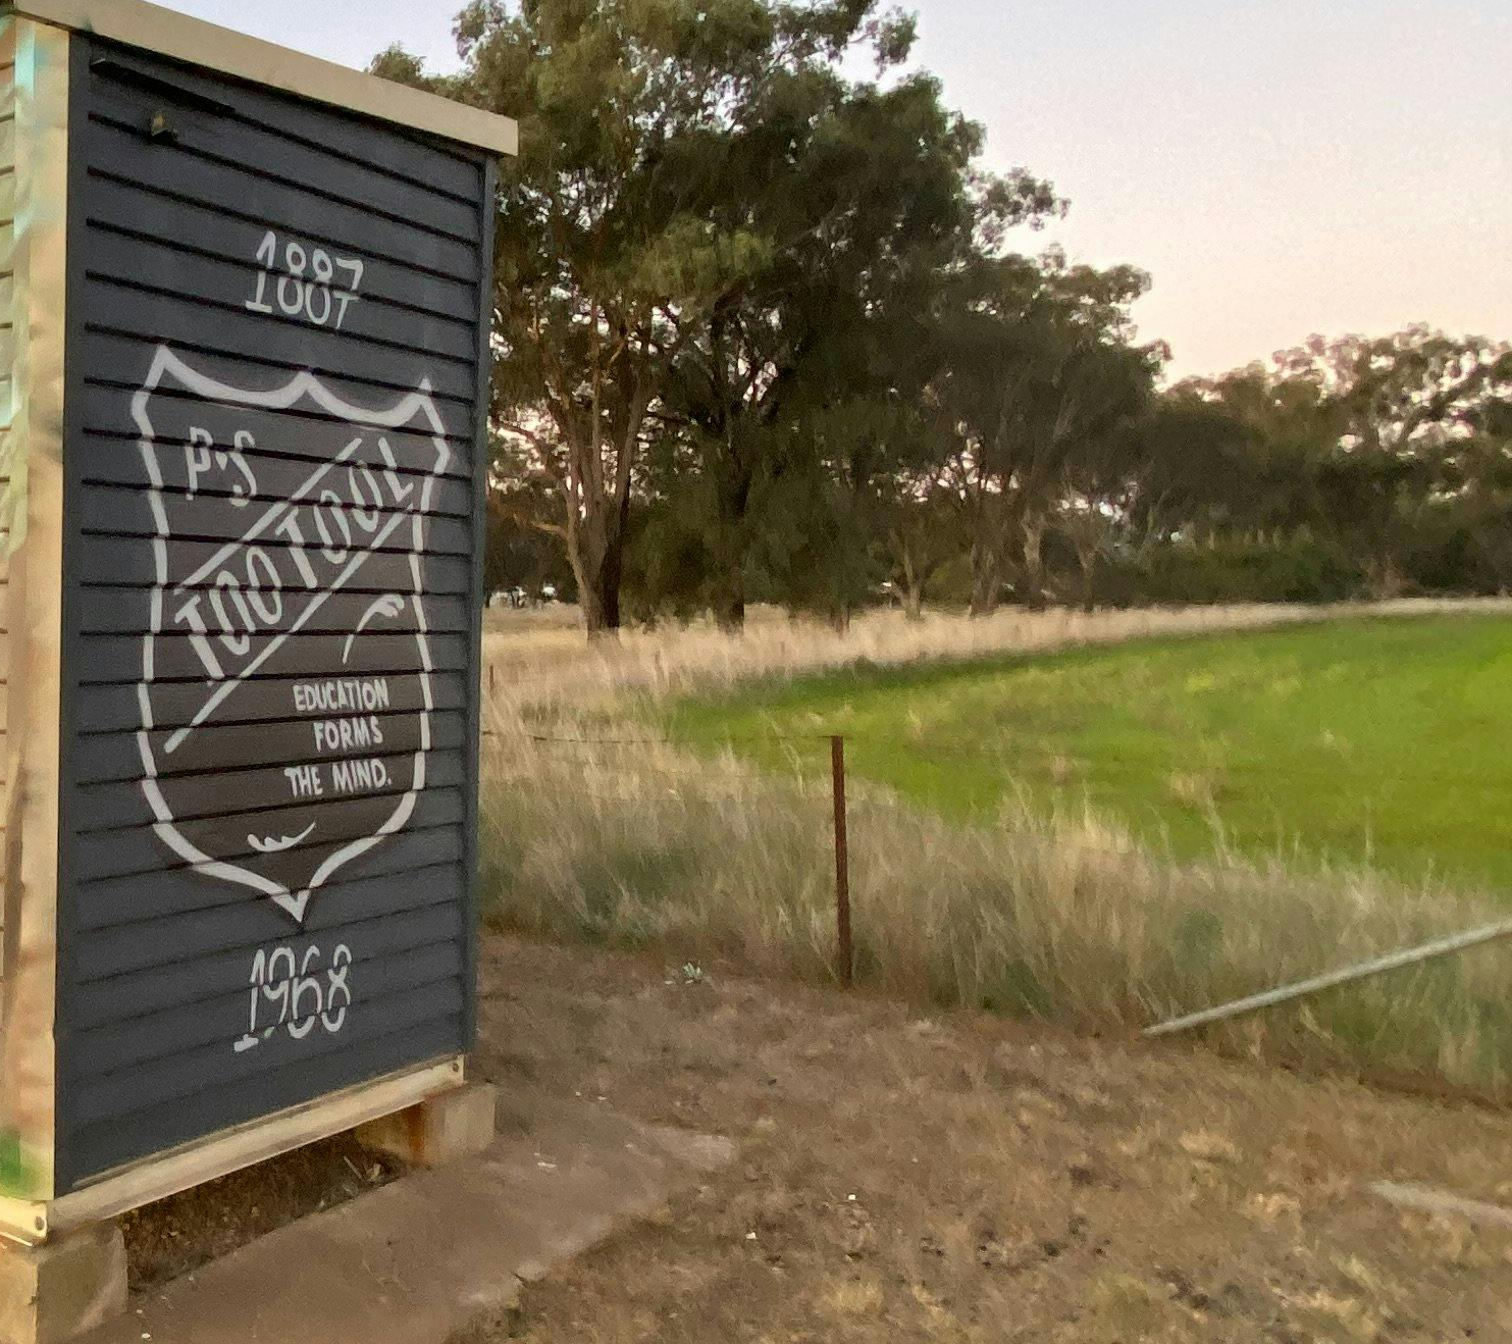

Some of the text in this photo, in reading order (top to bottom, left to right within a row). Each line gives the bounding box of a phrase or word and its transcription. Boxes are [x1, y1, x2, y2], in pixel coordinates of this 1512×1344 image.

[245, 230, 364, 329] 1887
[293, 678, 390, 711] EDUCATION
[313, 715, 384, 753] FORMS
[284, 758, 392, 797] THE MIND.
[233, 943, 352, 1052] 1968
